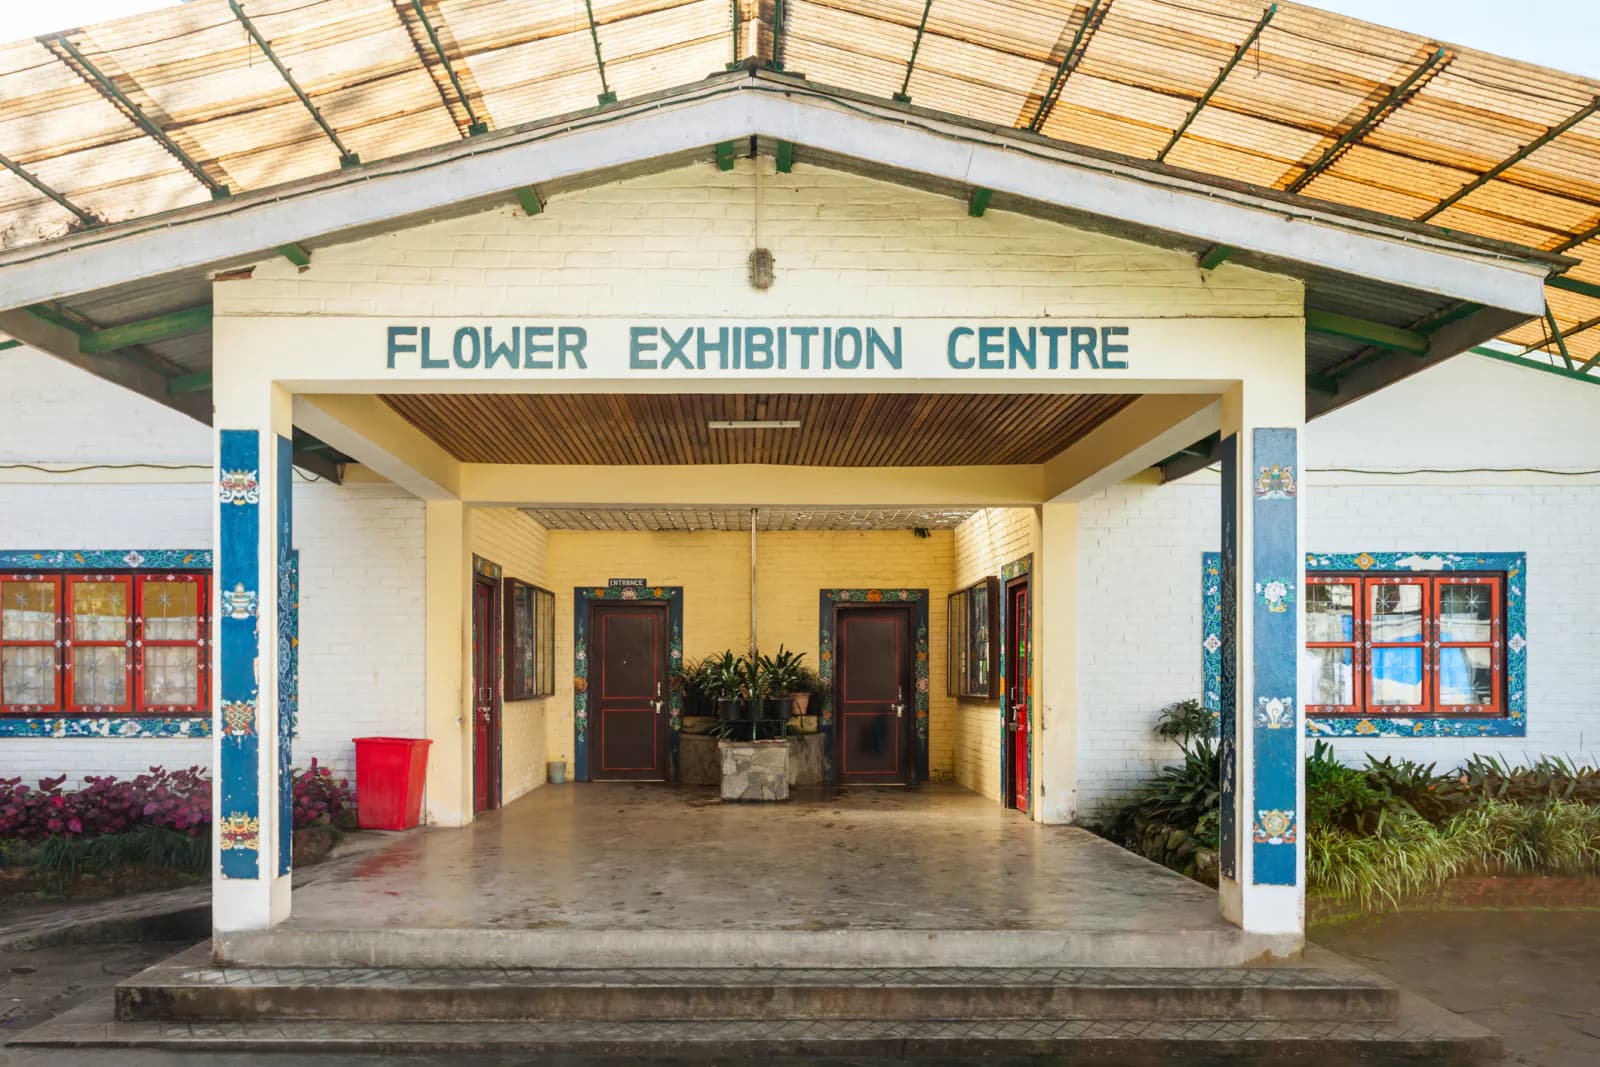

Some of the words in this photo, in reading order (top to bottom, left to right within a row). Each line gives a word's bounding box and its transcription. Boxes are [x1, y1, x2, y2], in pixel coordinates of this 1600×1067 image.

[387, 326, 587, 369] FLOWER
[629, 326, 902, 369] EXHIBITION
[948, 326, 1129, 369] CENTRE
[609, 579, 644, 587] ENTRANCE
